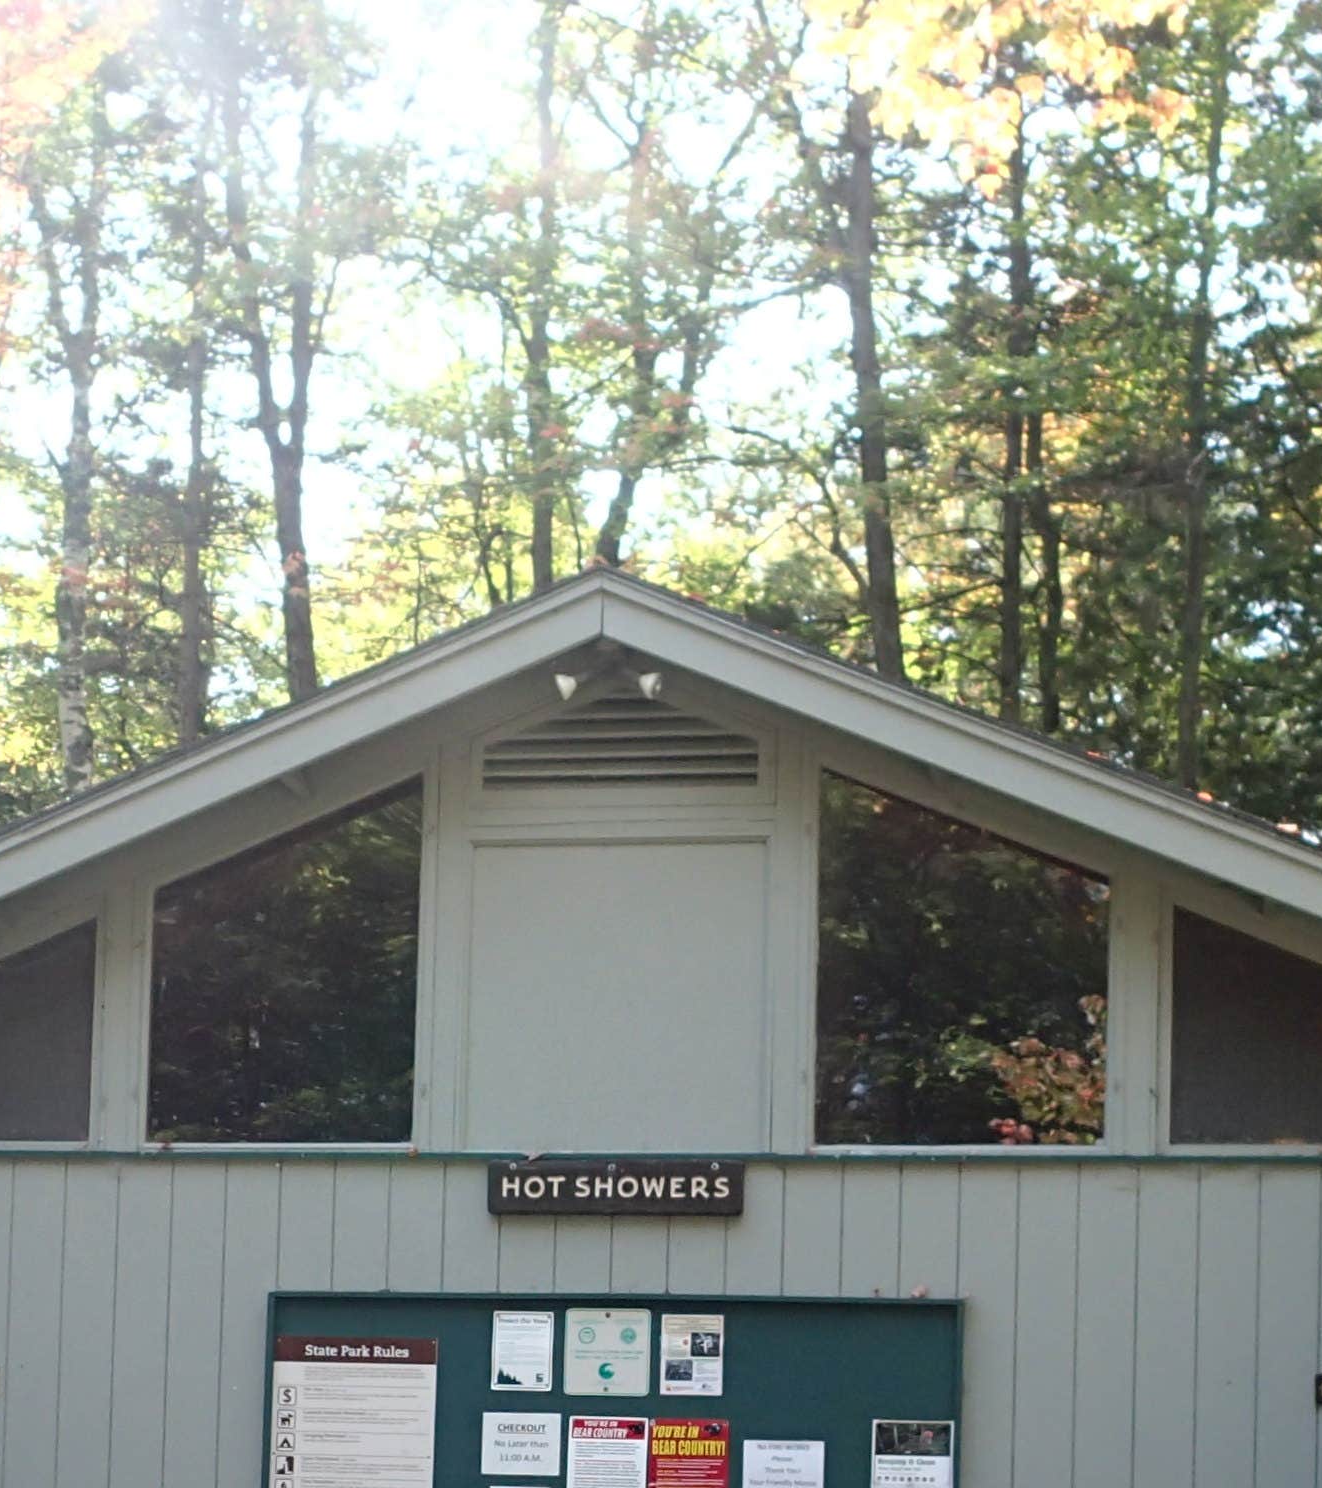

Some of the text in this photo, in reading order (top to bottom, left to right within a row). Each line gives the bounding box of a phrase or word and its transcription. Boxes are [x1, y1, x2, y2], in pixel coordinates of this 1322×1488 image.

[501, 1176, 730, 1199] HOT SHOWERS
[305, 1344, 409, 1358] State Park Rules
[497, 1423, 546, 1433] CHECKOUT
[573, 1428, 628, 1439] BEAR COUNTRY
[652, 1425, 699, 1438] YOU'RE IN
[508, 1440, 528, 1448] Later
[530, 1440, 549, 1448] than
[652, 1440, 726, 1457] BEAR COUNTRY!
